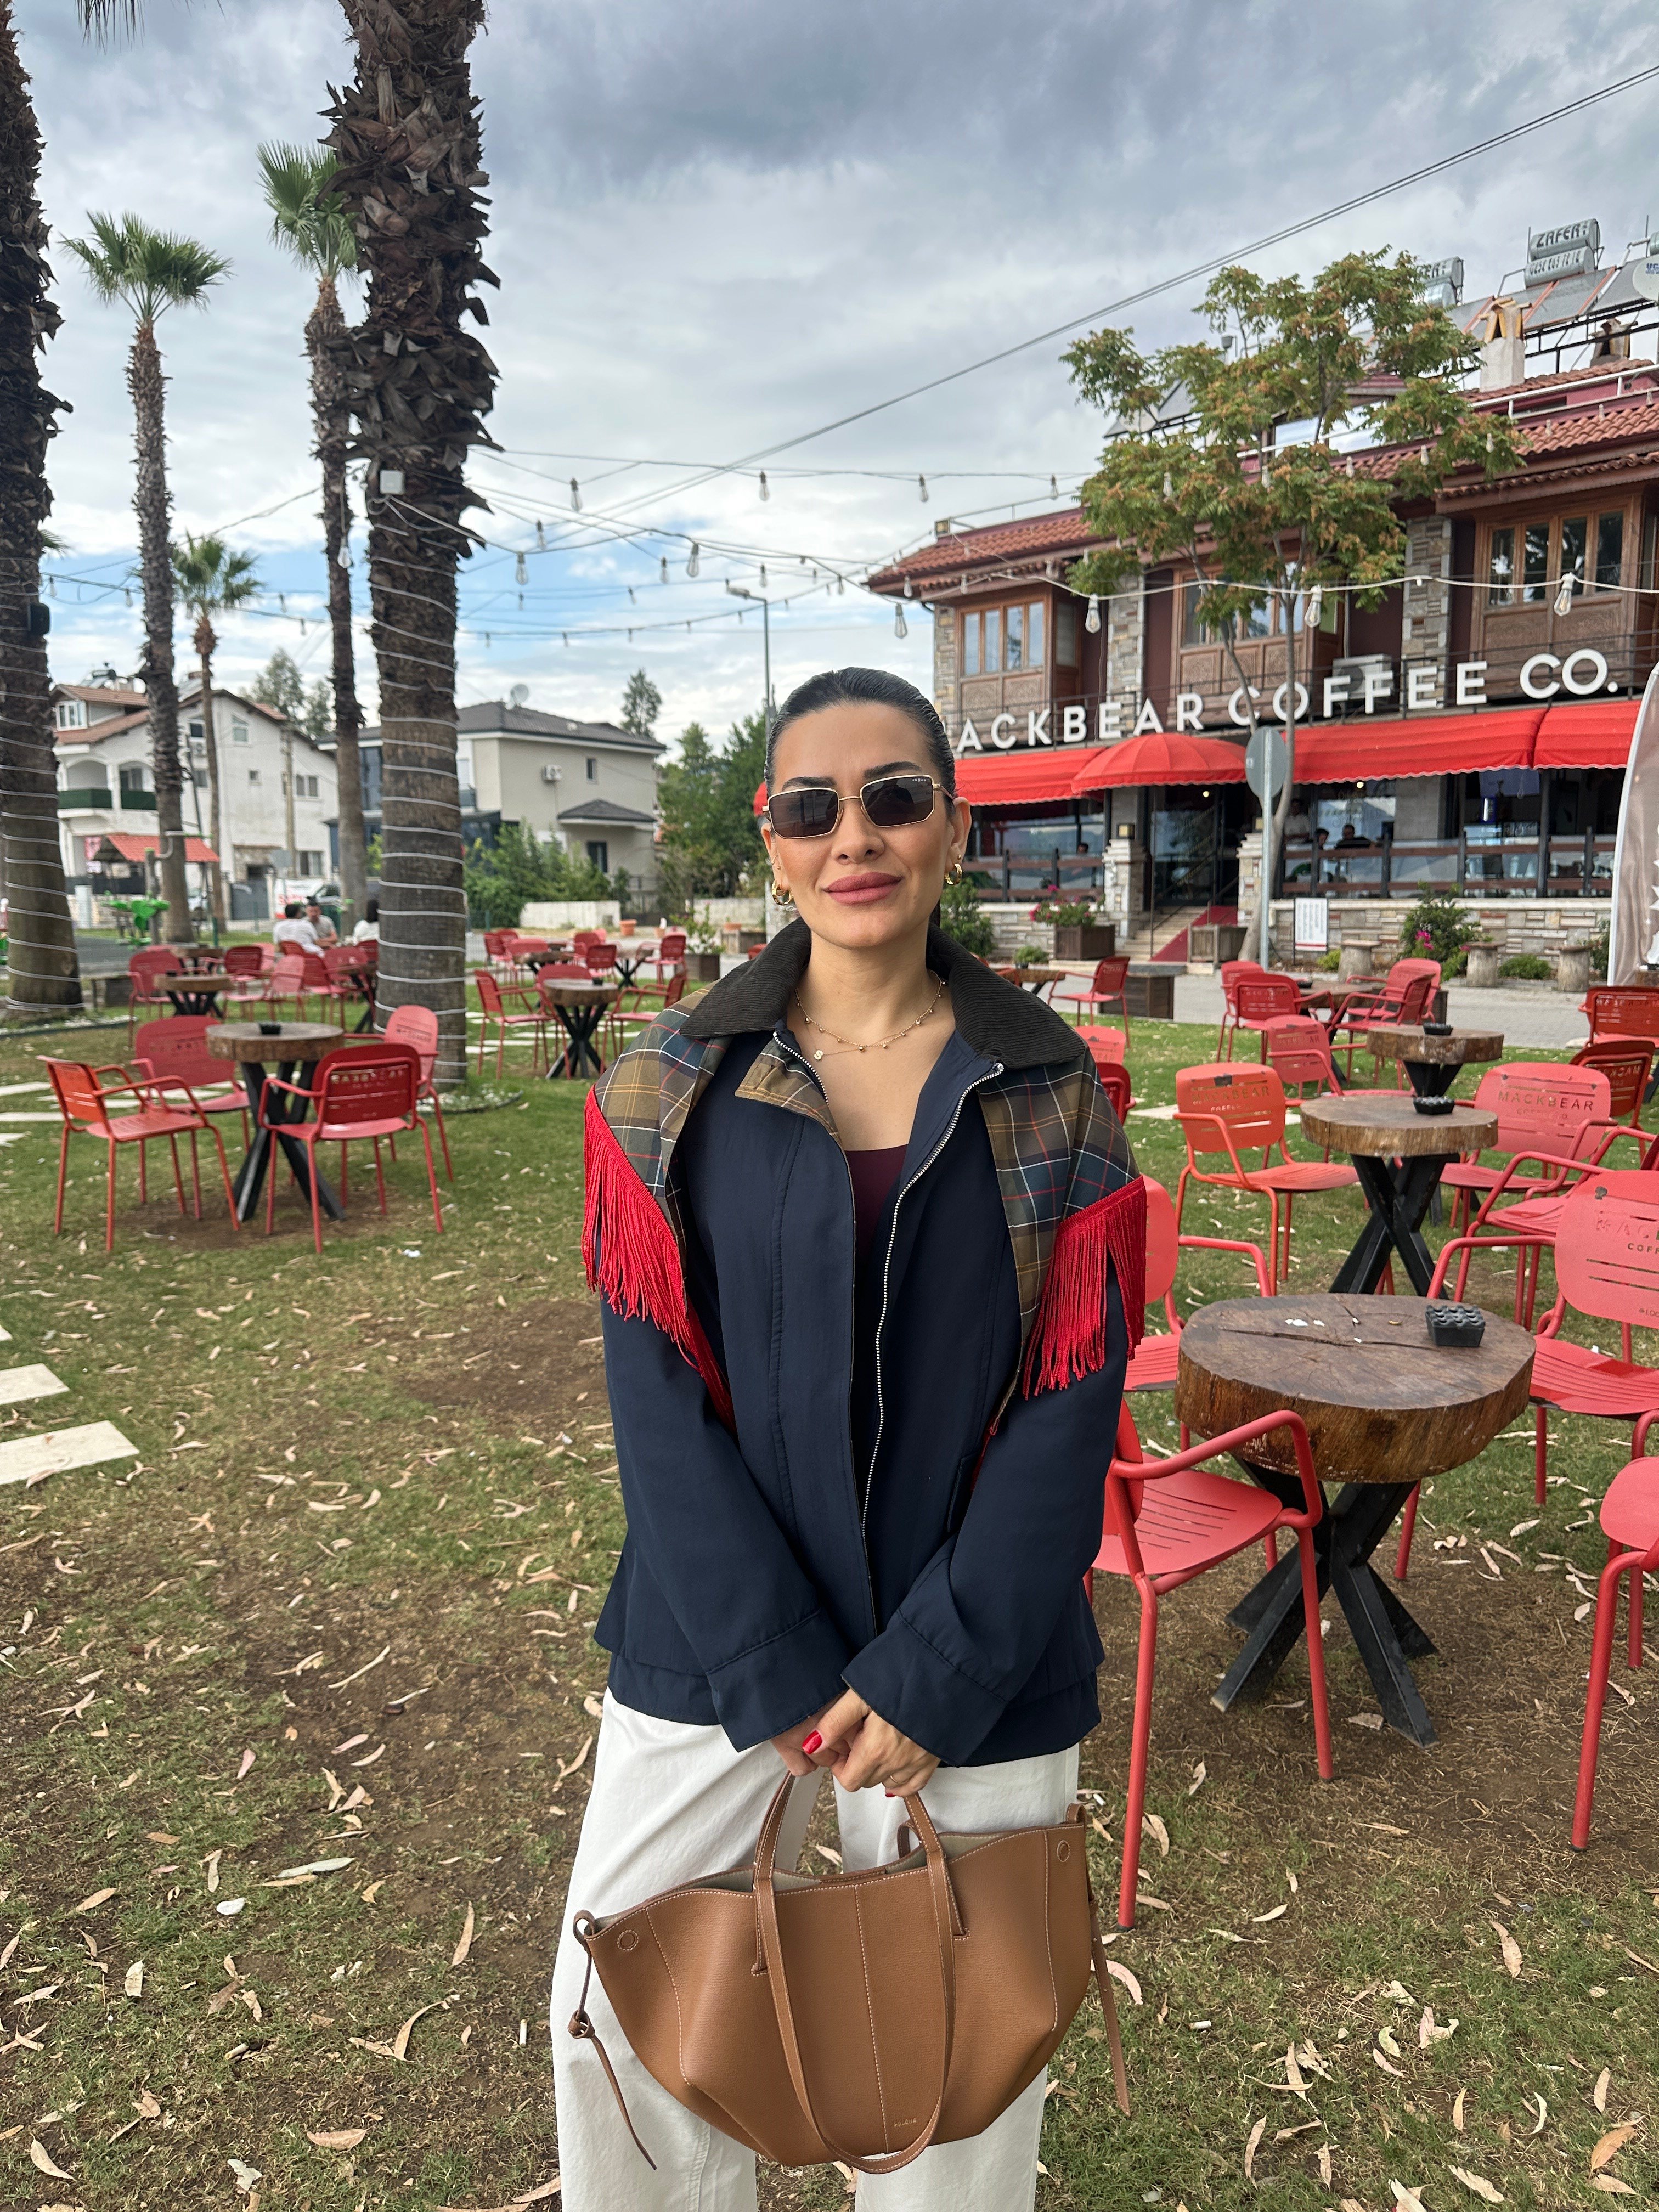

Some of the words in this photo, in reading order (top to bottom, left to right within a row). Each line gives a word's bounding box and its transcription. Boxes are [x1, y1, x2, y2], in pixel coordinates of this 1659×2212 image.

[1536, 223, 1581, 248] ZAFER
[942, 692, 1204, 753] ACKBEAR
[1228, 661, 1488, 726] COFFEE
[1520, 648, 1618, 699] CO.
[1498, 1090, 1593, 1111] MACKBEAR
